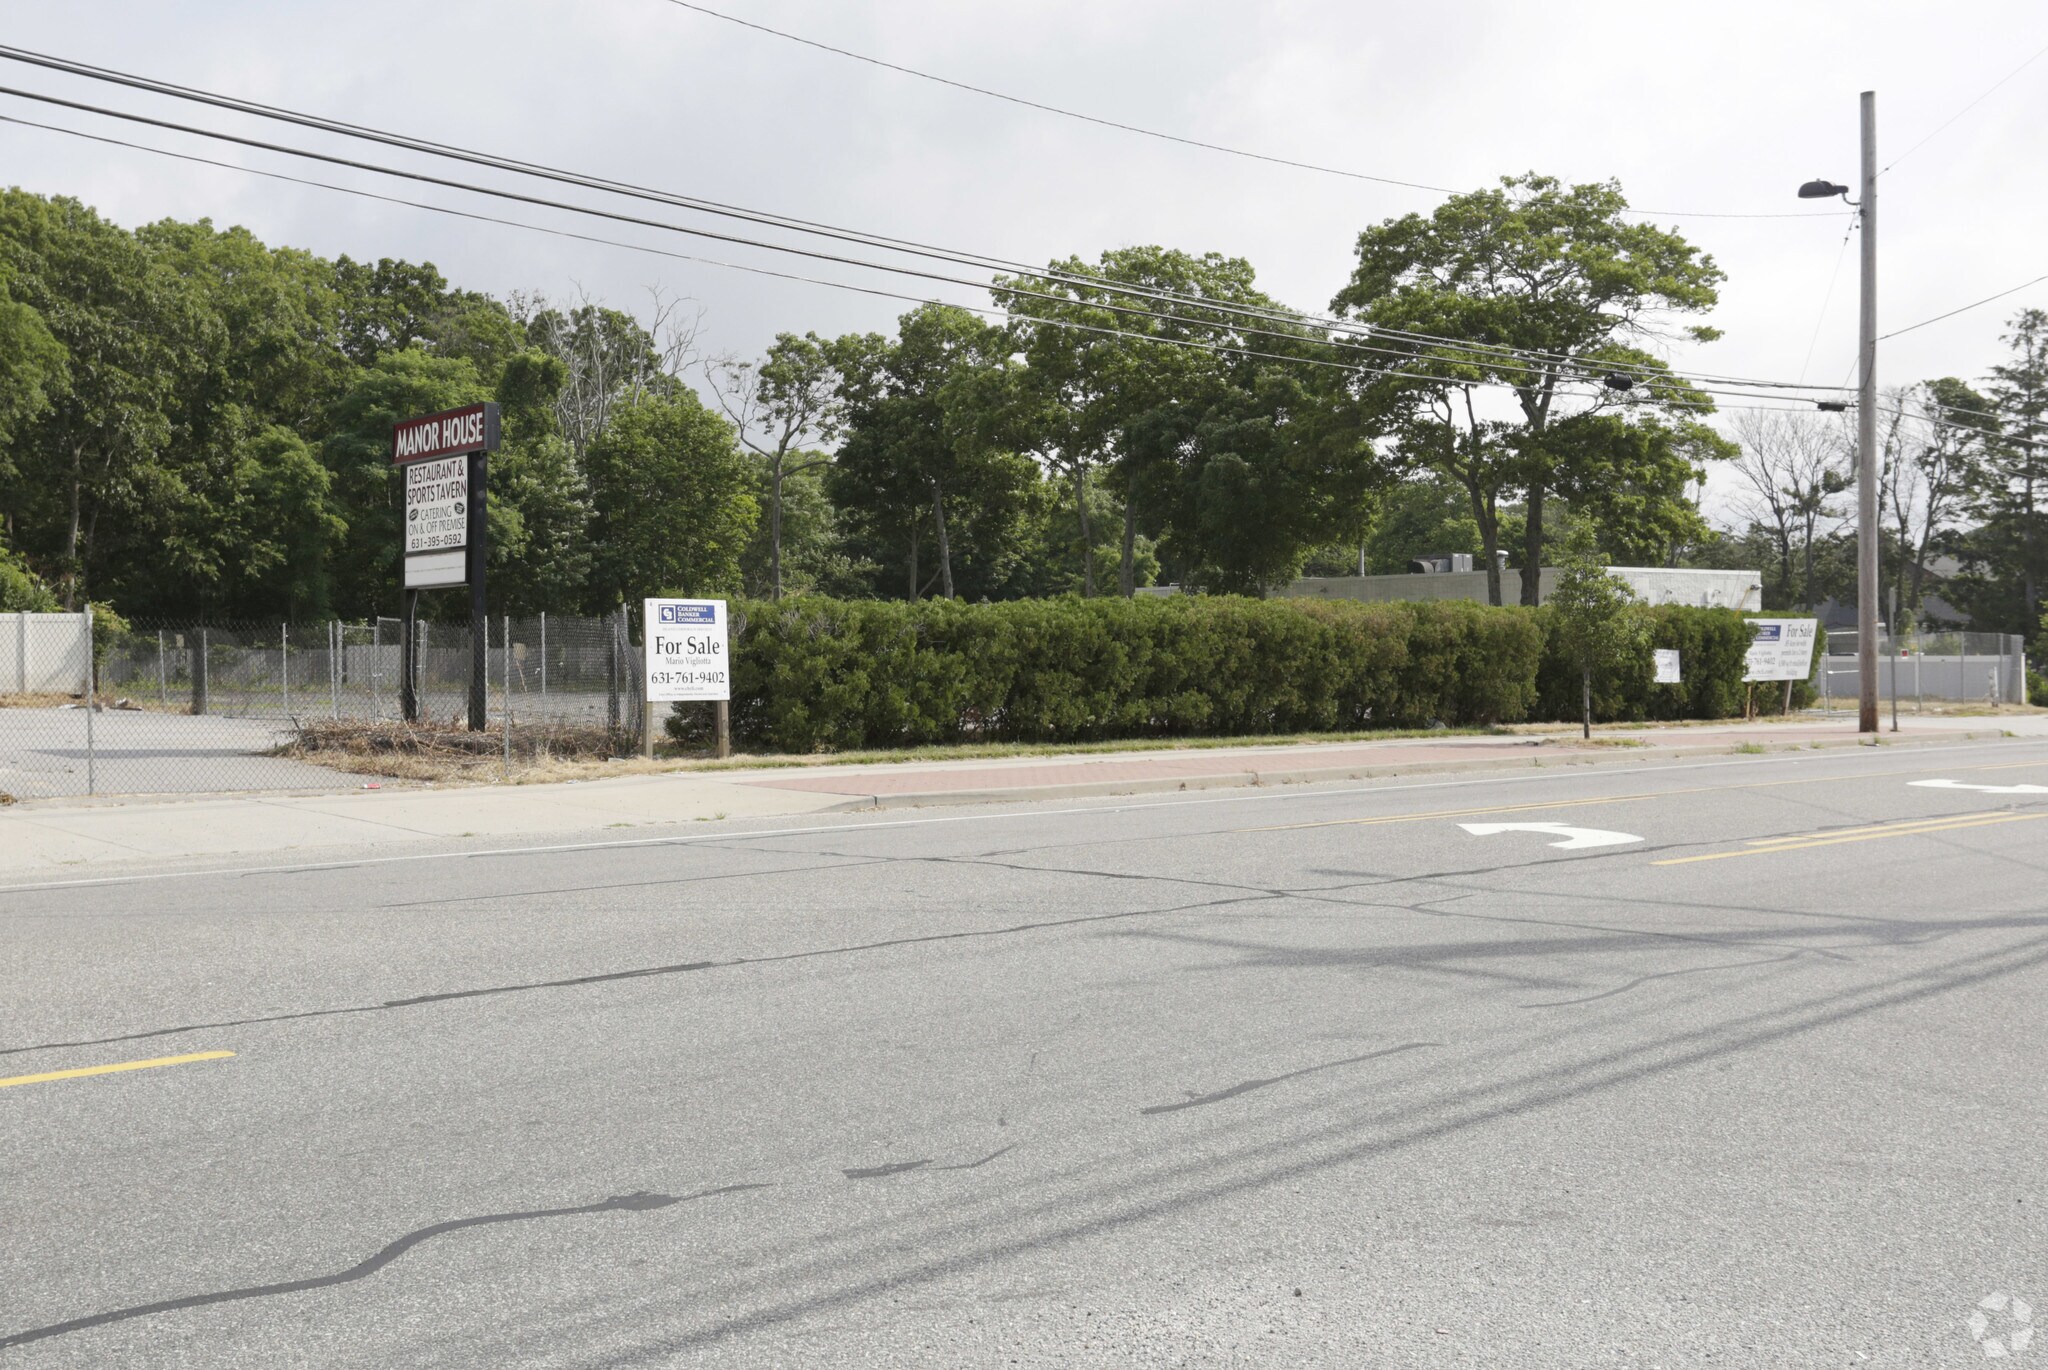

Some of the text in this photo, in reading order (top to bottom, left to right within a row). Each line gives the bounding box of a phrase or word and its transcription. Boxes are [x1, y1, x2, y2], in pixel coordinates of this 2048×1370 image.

[396, 412, 483, 458] MANOR HOUSE
[409, 459, 464, 486] RESTAURANT &
[407, 479, 467, 506] SPORTS TAVERN
[420, 505, 452, 521] CATERING
[408, 517, 465, 536] ON & OFF PREMISE
[411, 533, 462, 549] 631-395-0592
[1786, 624, 1813, 637] For Sale
[655, 635, 720, 655] For Sale
[665, 657, 684, 665] Mario
[651, 671, 725, 684] 631-761-9402
